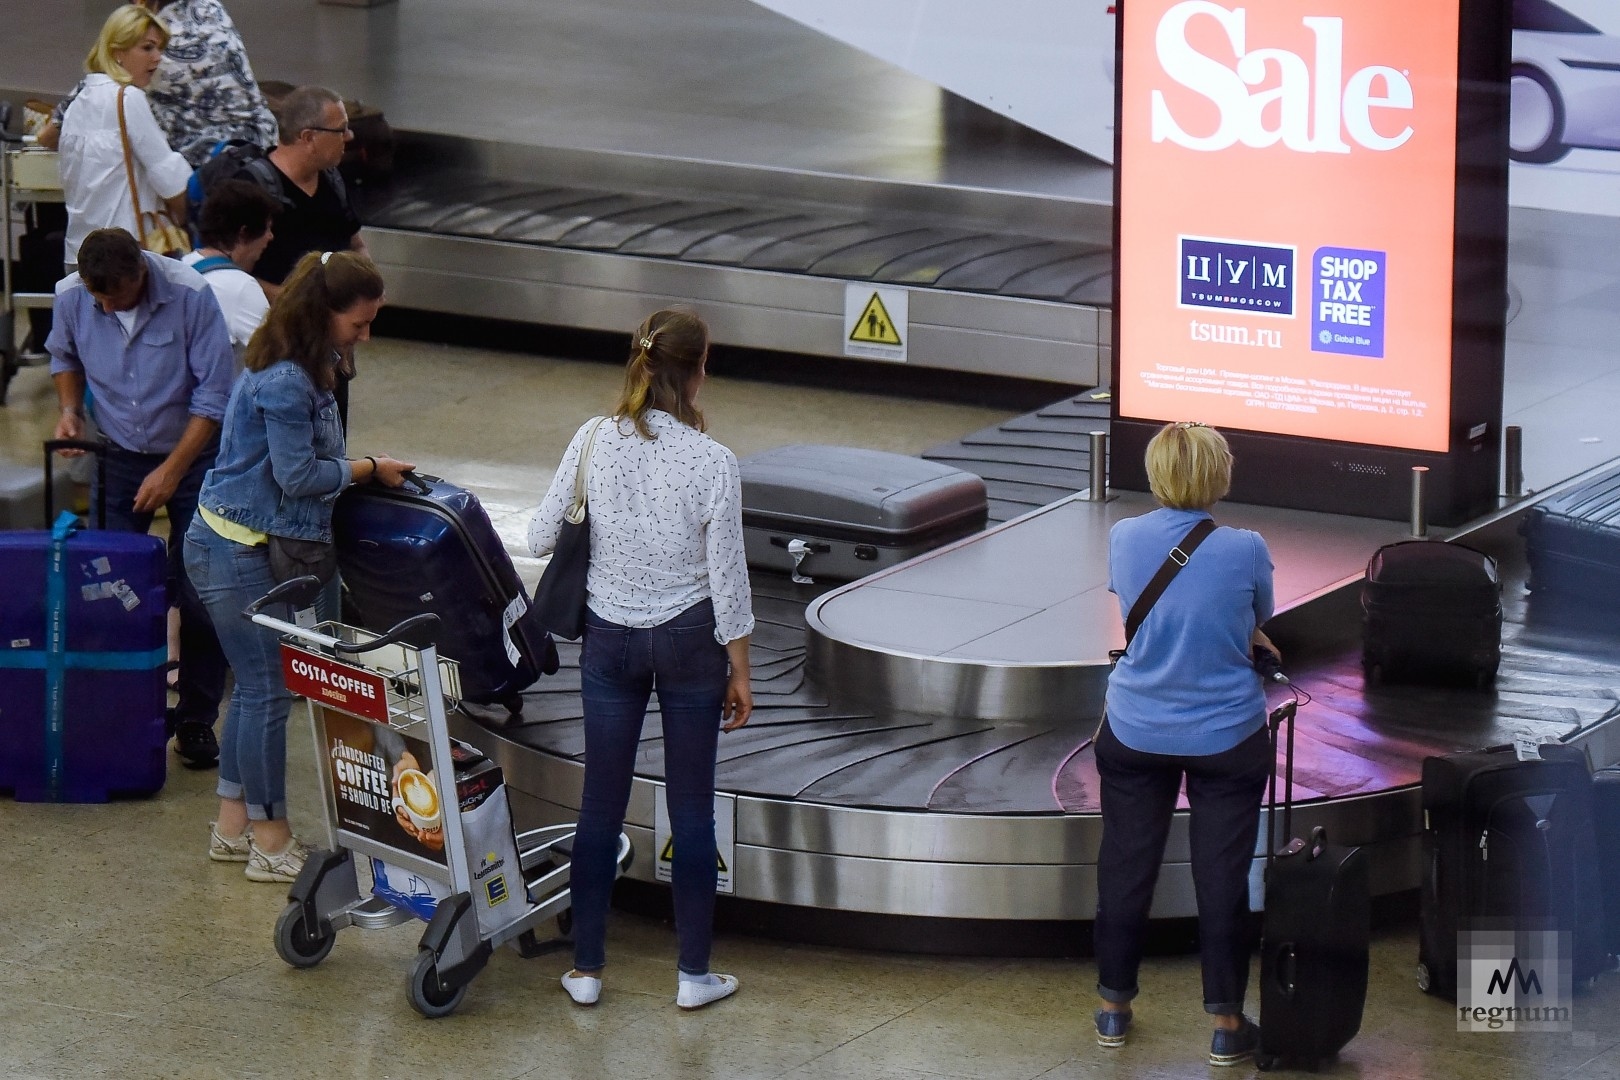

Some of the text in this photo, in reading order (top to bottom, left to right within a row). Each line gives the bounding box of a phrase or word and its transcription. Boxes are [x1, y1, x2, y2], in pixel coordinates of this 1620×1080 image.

[1151, 0, 1414, 154] Sale
[1319, 255, 1378, 281] SHOP
[1191, 292, 1282, 308] TSUM MOSCOW
[1319, 279, 1363, 303] TAX
[1189, 318, 1283, 349] tsum.ru
[1333, 332, 1371, 346] Global Blue
[291, 658, 375, 700] COSTA COFFEE
[335, 758, 390, 798] COFFEE
[348, 786, 392, 815] SHOULD BE
